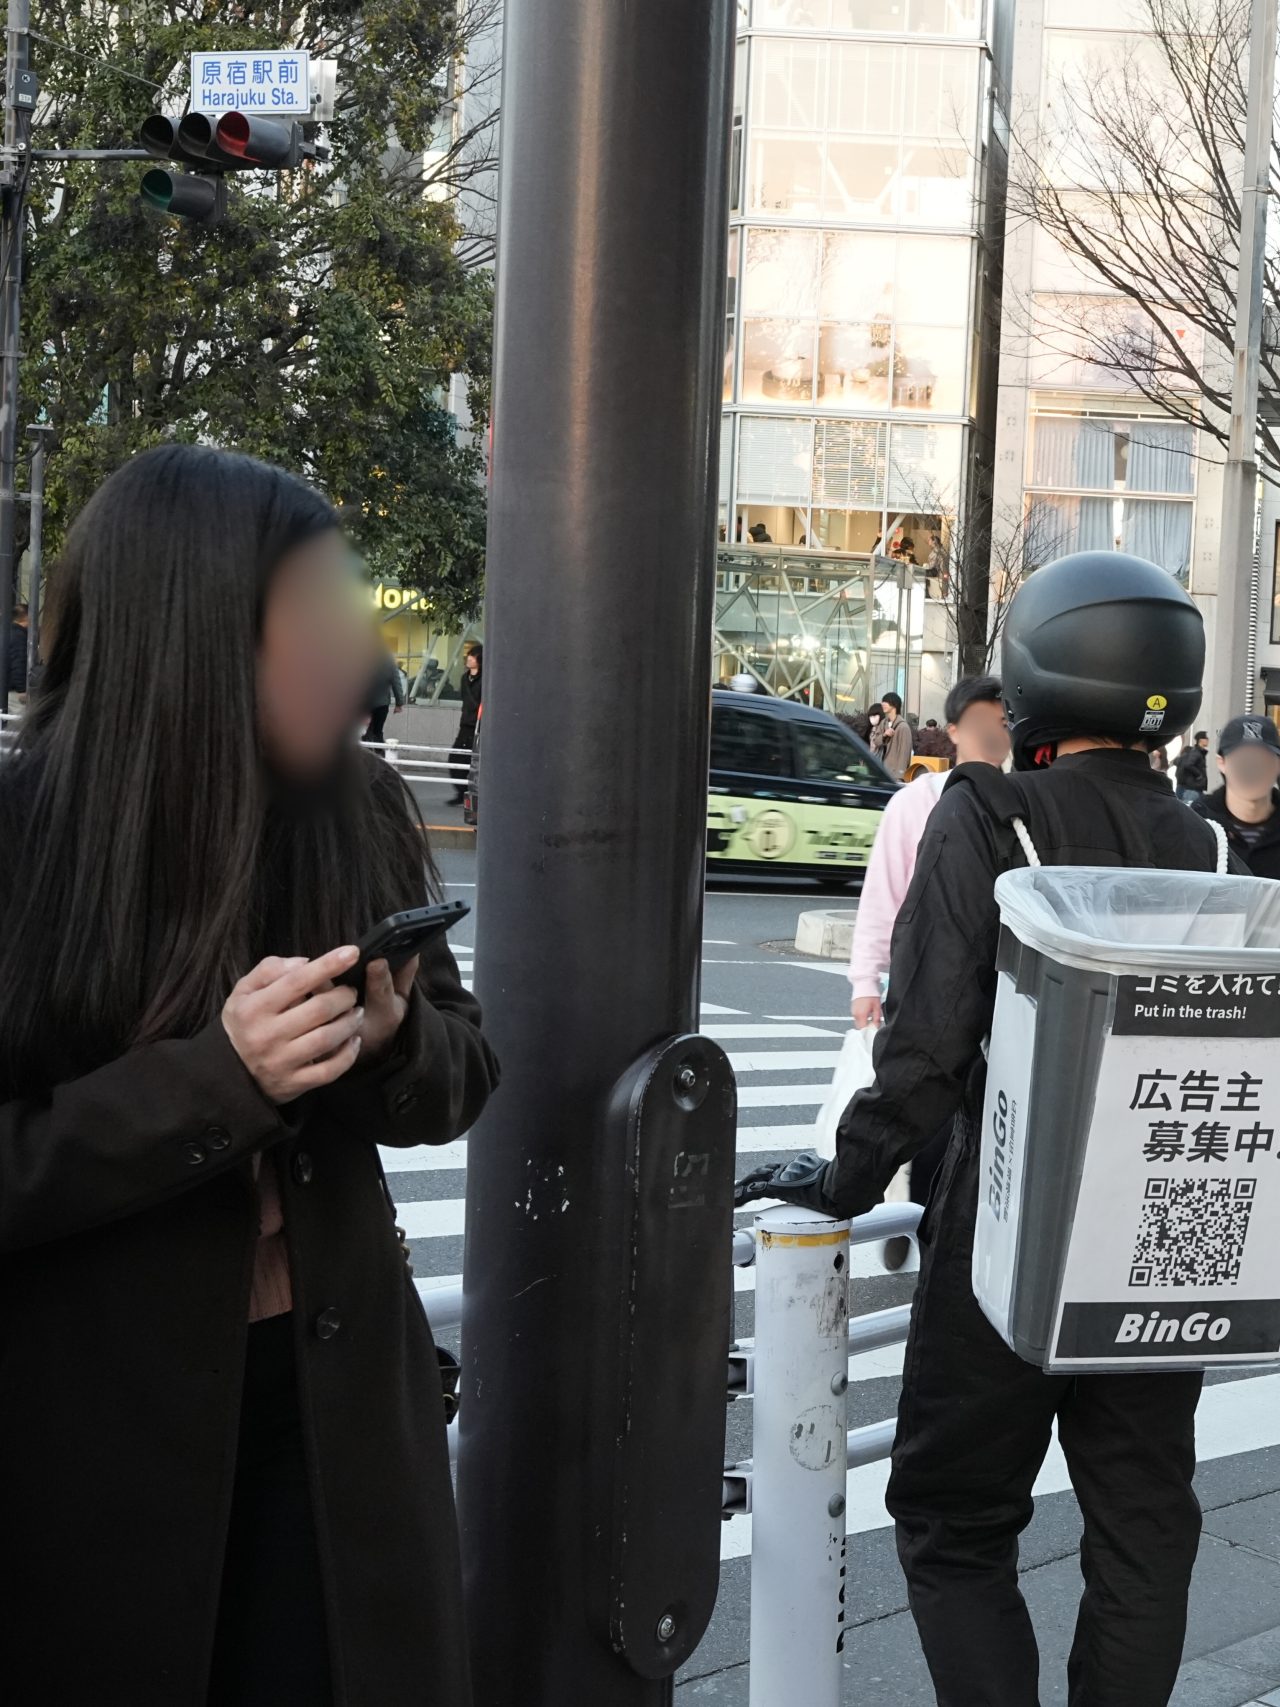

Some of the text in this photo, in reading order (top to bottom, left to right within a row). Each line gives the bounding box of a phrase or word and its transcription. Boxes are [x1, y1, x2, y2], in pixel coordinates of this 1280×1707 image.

[201, 59, 299, 85] 原宿駅前
[202, 87, 299, 109] Harajuku Sta.
[1134, 1003, 1247, 1019] Put in the trash!
[1129, 1068, 1263, 1112] 広告主
[989, 1089, 1008, 1223] BinGo
[1114, 1310, 1231, 1343] BinGo
